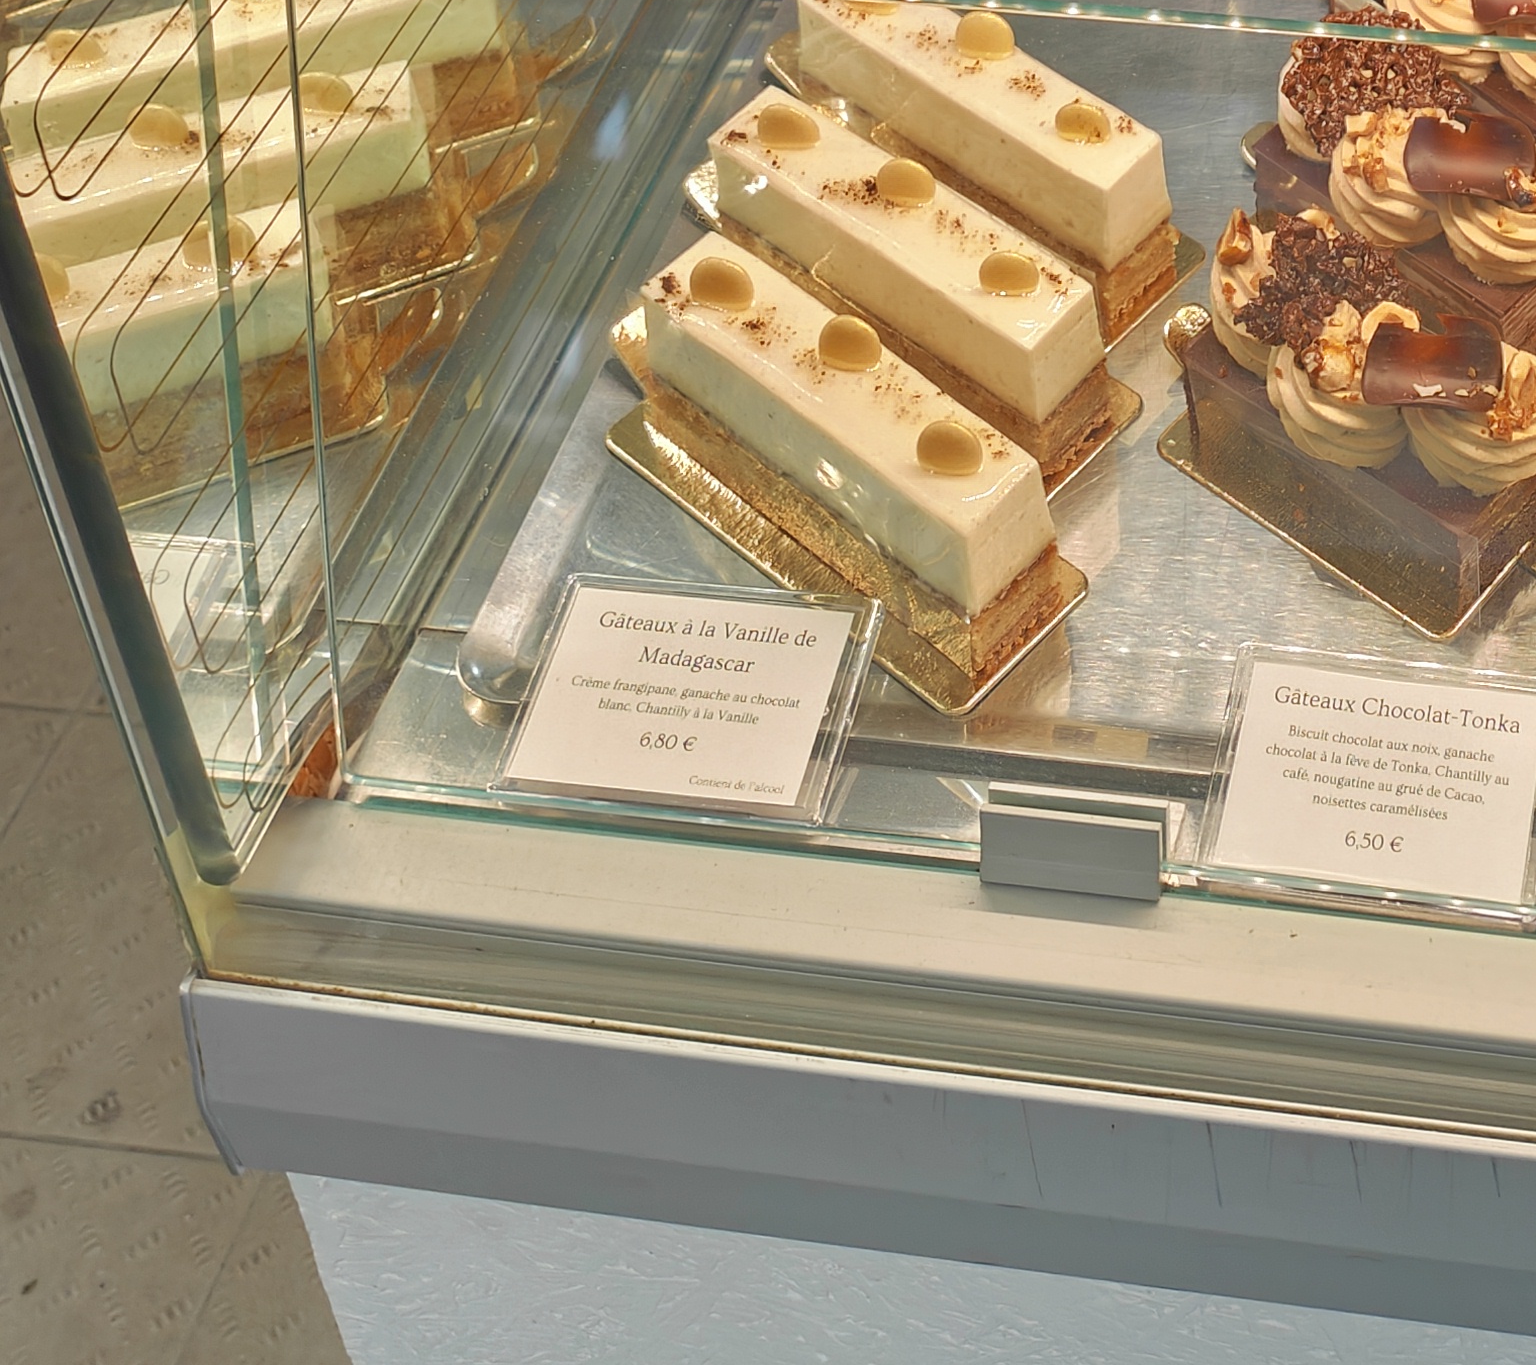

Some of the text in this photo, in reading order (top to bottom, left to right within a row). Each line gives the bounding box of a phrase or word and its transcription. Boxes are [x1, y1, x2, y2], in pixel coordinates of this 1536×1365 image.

[599, 611, 817, 648] Gâteaux à la Vanille de
[638, 646, 755, 674] Madagascar
[571, 675, 611, 690] Crème
[681, 686, 730, 701] ganache
[733, 692, 747, 703] au
[750, 692, 800, 709] chocolat
[636, 701, 689, 720] Chantilly
[693, 705, 699, 717] à
[703, 708, 714, 721] la
[717, 709, 759, 725] Vanille
[1274, 686, 1520, 734] Gâteaux Chocolat-Tonka
[639, 731, 697, 752] 6,80 €
[1288, 725, 1494, 763] Biscuit chocolat aux noix, ganache
[1266, 744, 1316, 761] chocolat
[1320, 751, 1328, 763] à
[1331, 751, 1342, 765] la
[1346, 753, 1369, 768] fève
[1372, 757, 1388, 770] de
[1435, 765, 1492, 785] Chantilly
[1494, 774, 1509, 786] au
[733, 779, 745, 790] de
[1313, 772, 1374, 793] nougatine
[1378, 780, 1392, 793] au
[1396, 781, 1423, 797] grué
[1426, 783, 1441, 798] de
[1444, 788, 1485, 805] Cacao,
[1312, 795, 1448, 820] noisettes caramélisées
[1344, 831, 1404, 853] 6,50 €
